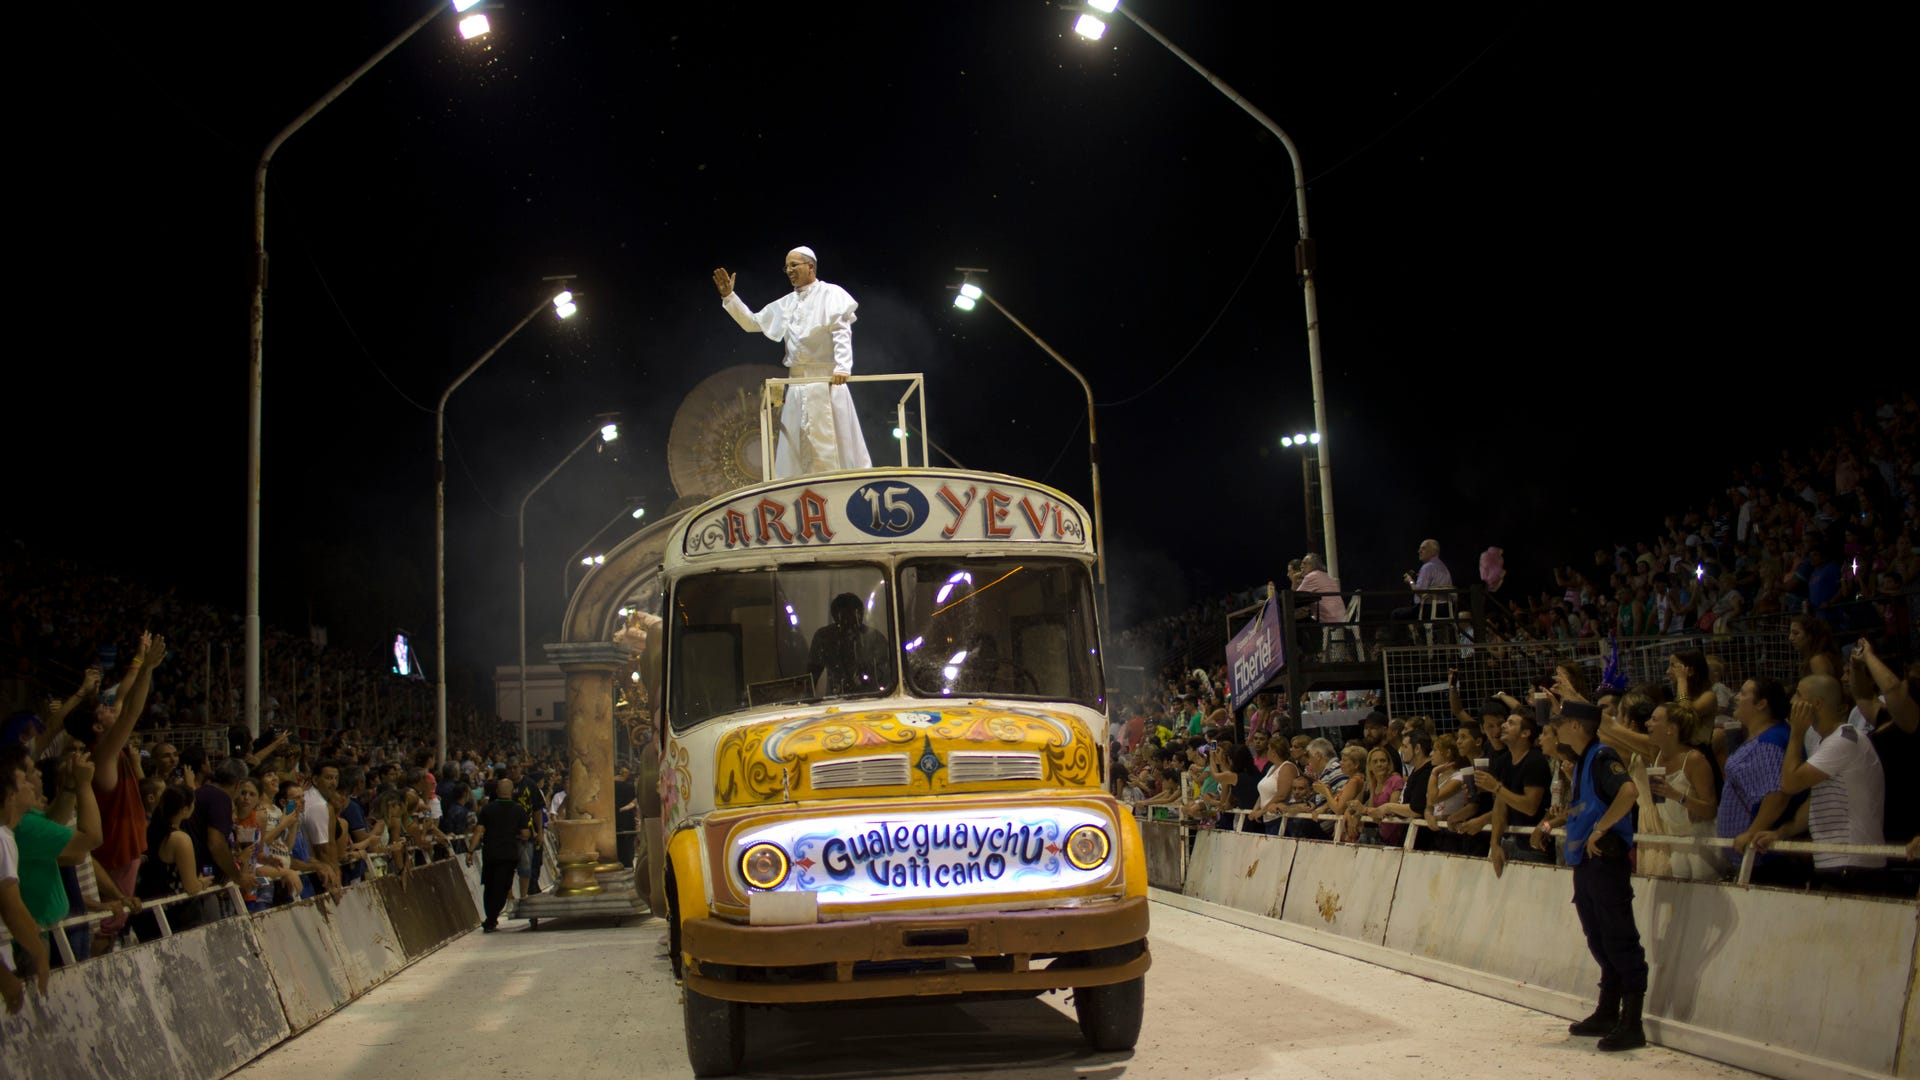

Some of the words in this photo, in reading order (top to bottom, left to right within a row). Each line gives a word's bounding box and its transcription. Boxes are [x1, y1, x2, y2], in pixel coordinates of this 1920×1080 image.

[723, 488, 836, 548] ARA
[859, 487, 916, 532] '15
[1234, 627, 1272, 695] FiberTel
